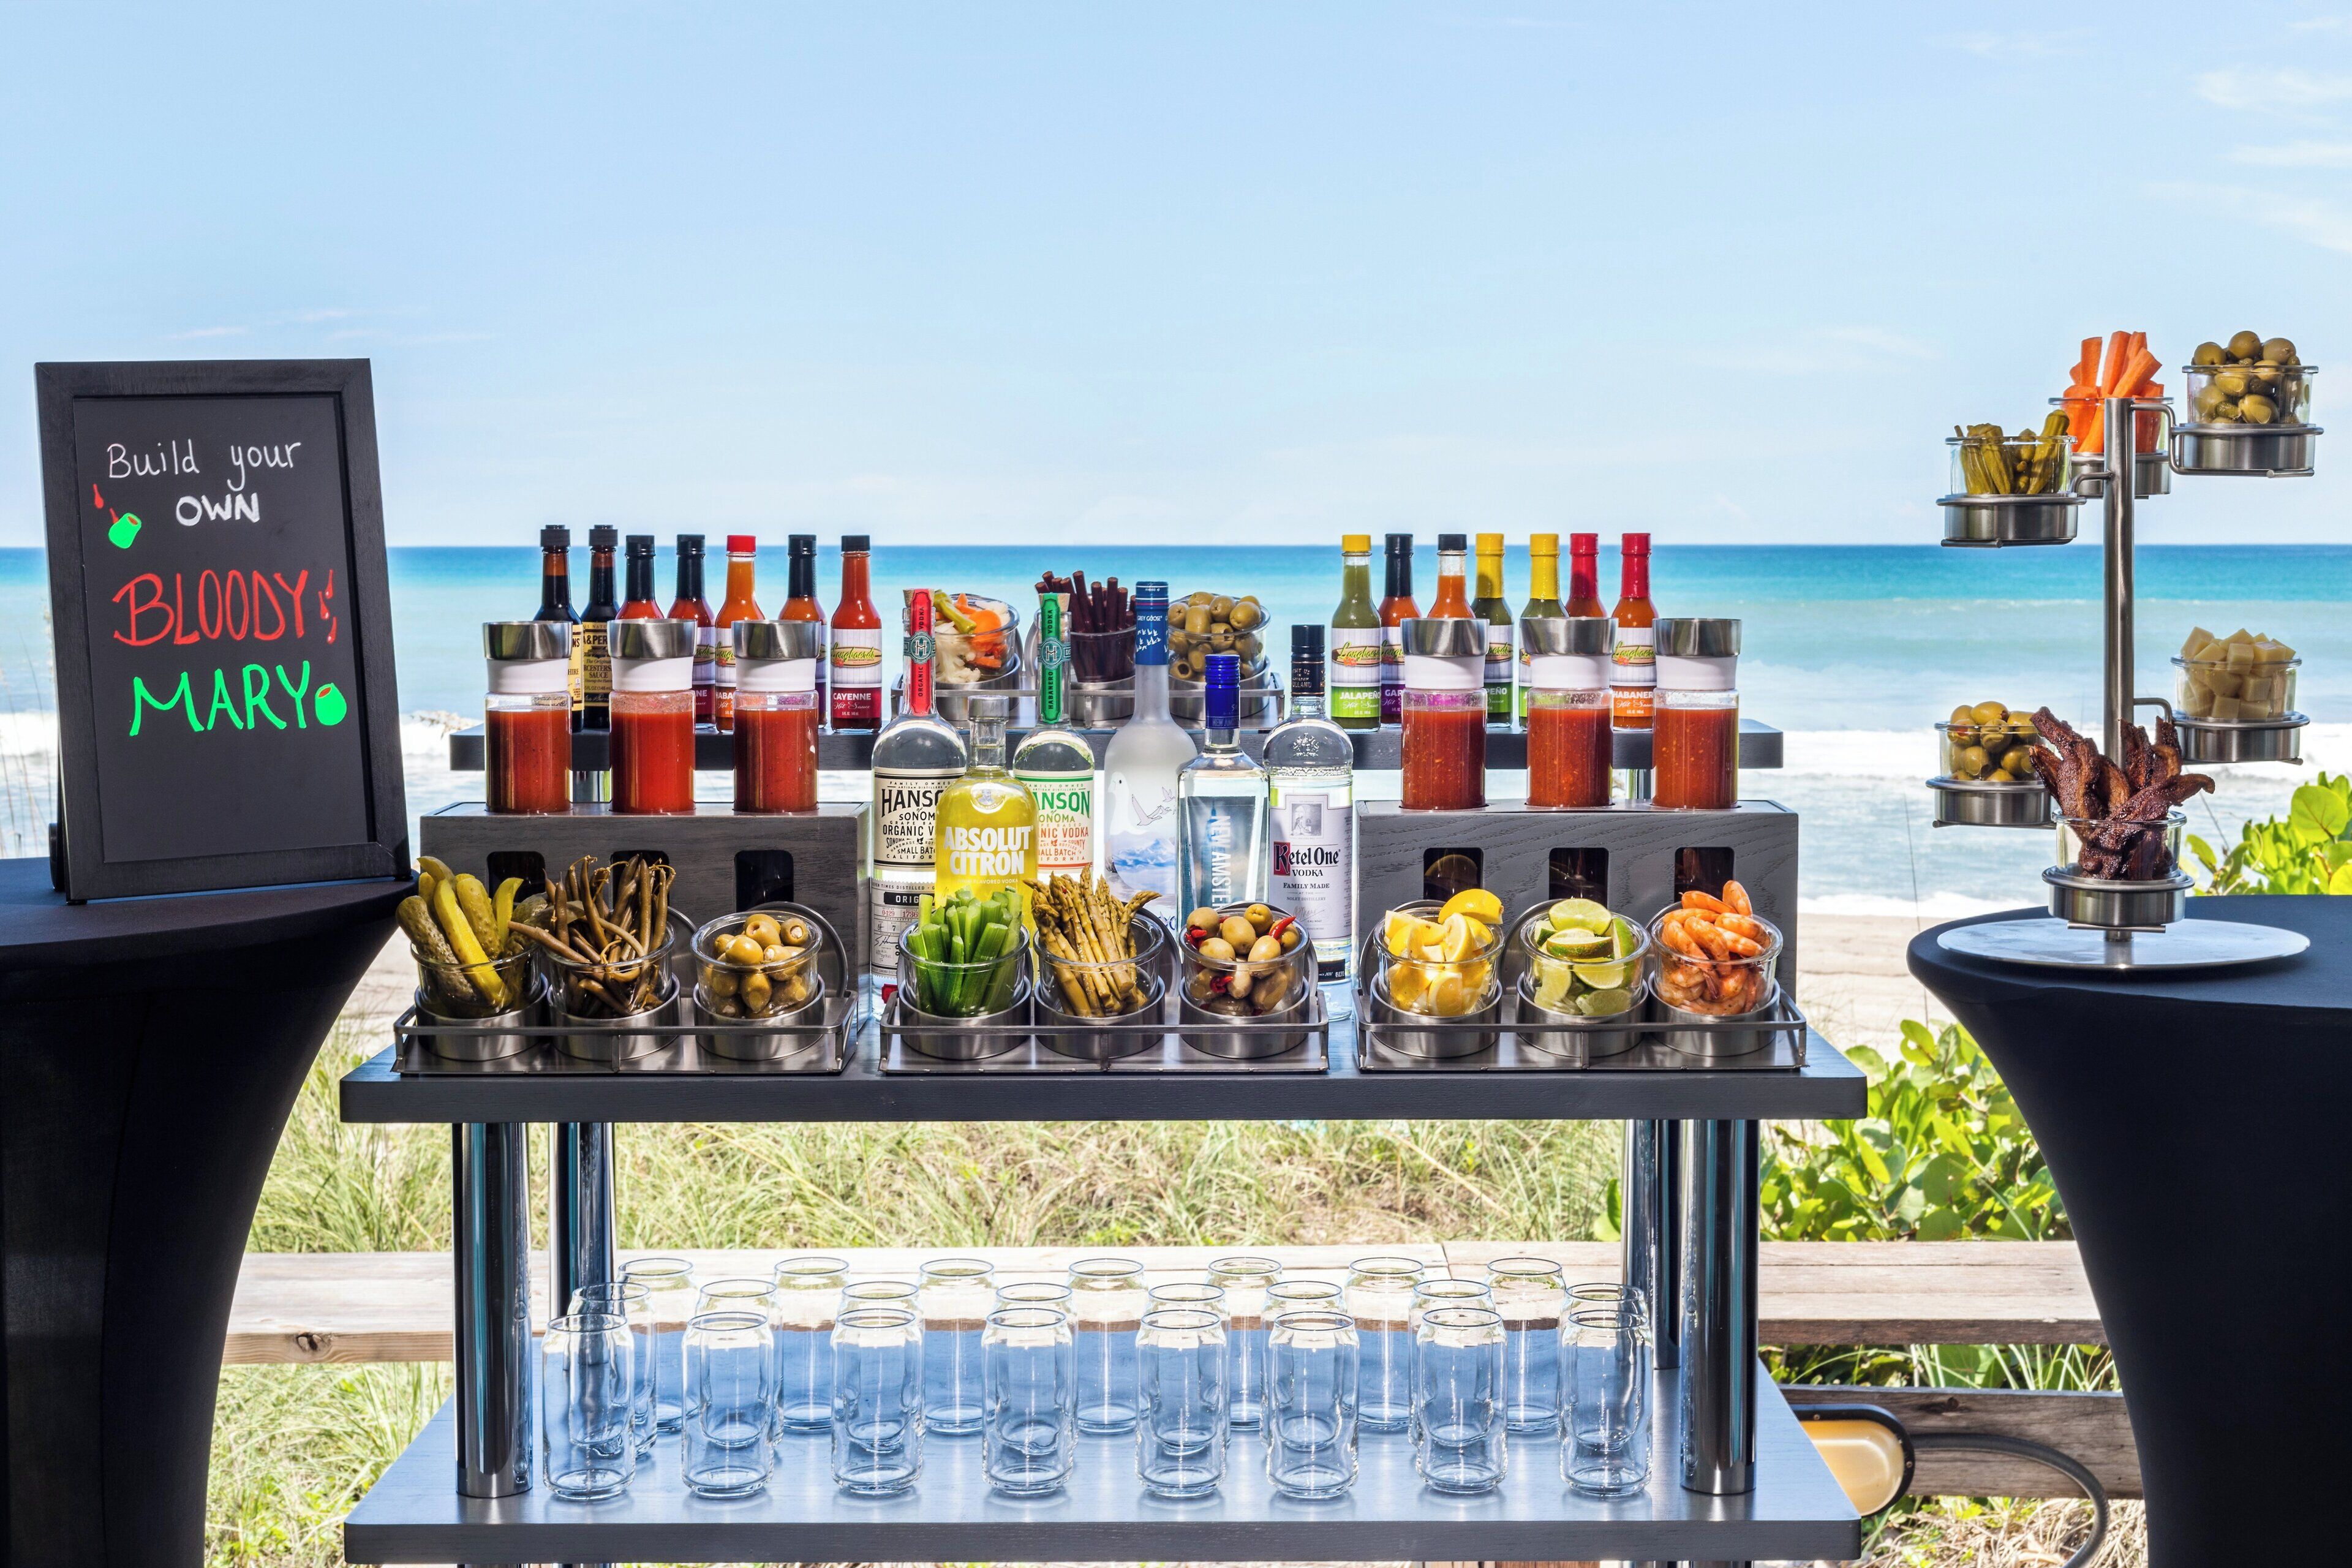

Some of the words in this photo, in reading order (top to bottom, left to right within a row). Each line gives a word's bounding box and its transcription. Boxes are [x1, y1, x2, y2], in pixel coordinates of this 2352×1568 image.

[108, 439, 200, 479] Build
[227, 440, 301, 491] your
[175, 492, 261, 527] OWN
[113, 569, 308, 647] BLOODY
[129, 660, 311, 736] MARY
[1613, 690, 1654, 699] HABANER
[833, 701, 846, 710] Hot
[848, 701, 870, 709] Sauce
[1616, 699, 1631, 708] Hot
[899, 811, 935, 821] SONOM
[1039, 813, 1076, 823] ONOMA
[883, 824, 924, 836] ORGANIC
[1062, 827, 1089, 838] VODKA
[1212, 815, 1231, 848] NEW
[886, 837, 905, 849] SONOMA
[944, 826, 1031, 852] ABSOLUT
[1068, 839, 1085, 850] COUNTY
[891, 840, 915, 853] HANDMADE
[949, 851, 1025, 876] CITRON
[1275, 844, 1312, 875] Ketel
[1314, 846, 1339, 865] One
[1292, 869, 1324, 877] VODKA
[895, 895, 919, 903] ORIG
